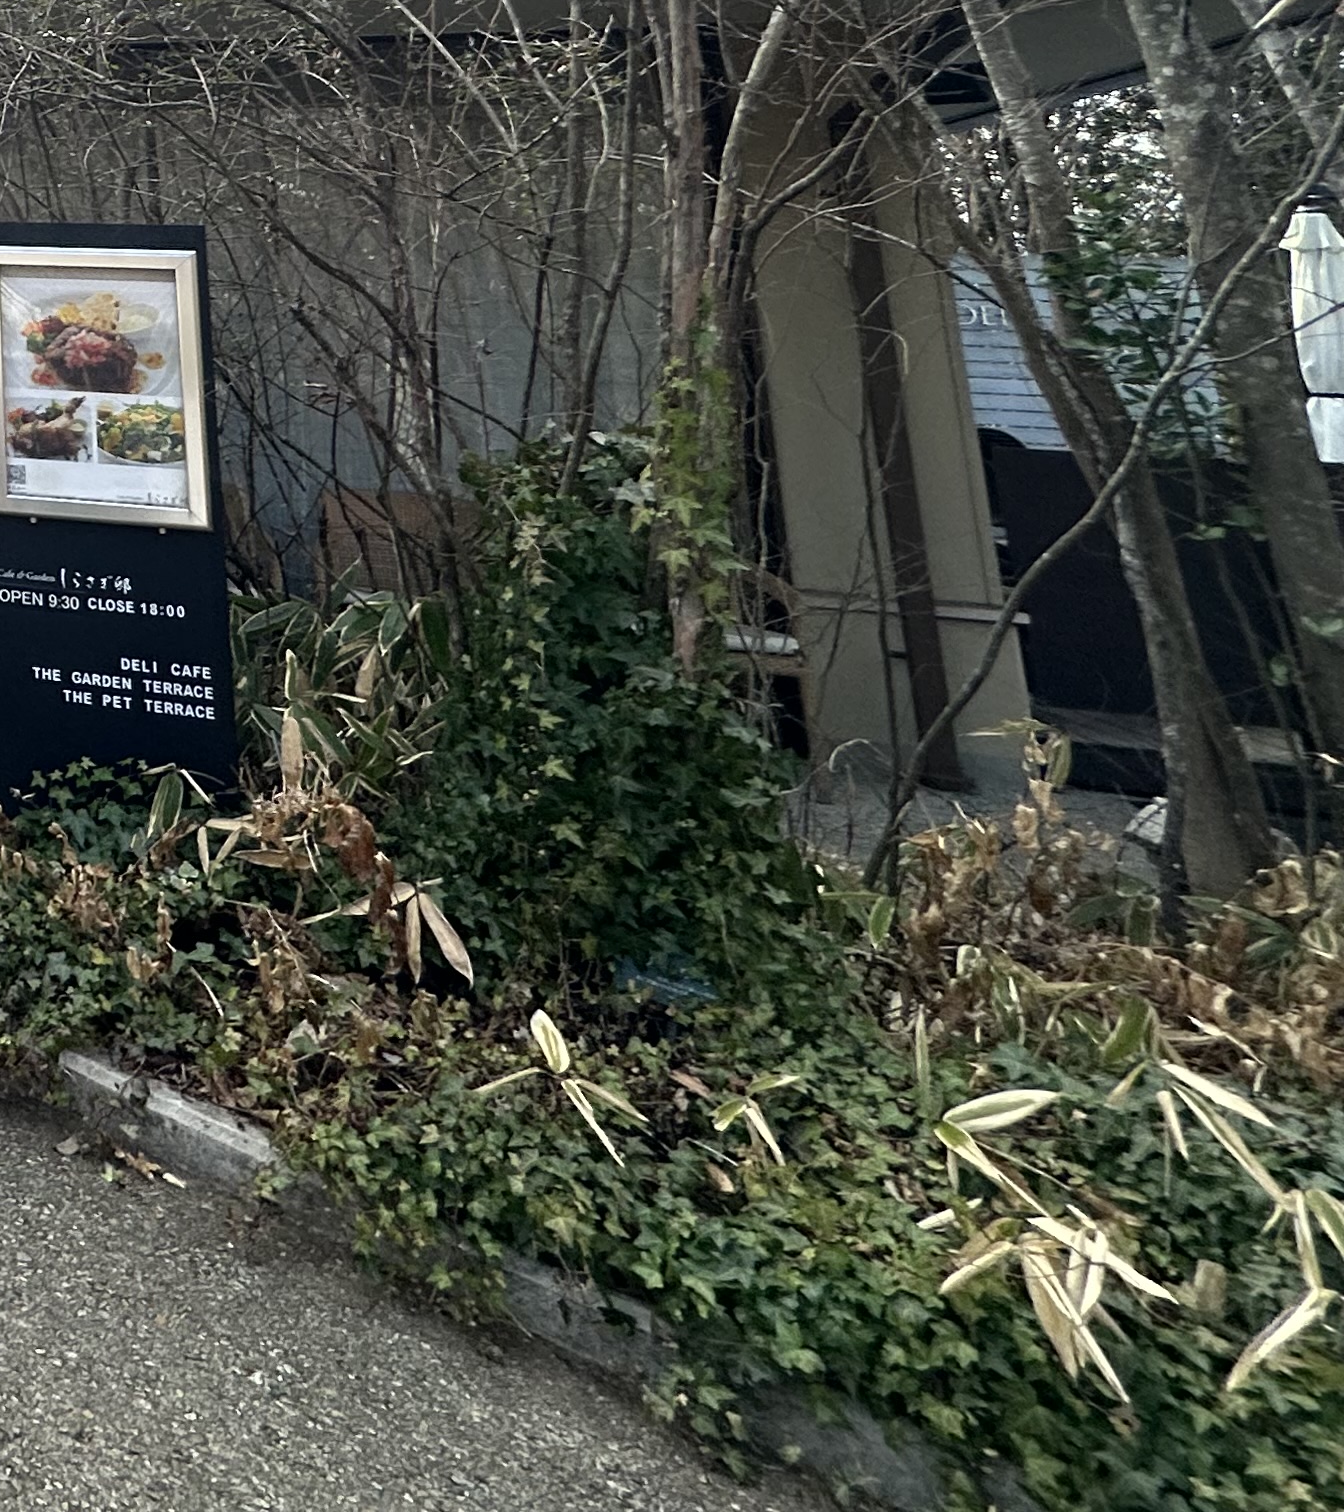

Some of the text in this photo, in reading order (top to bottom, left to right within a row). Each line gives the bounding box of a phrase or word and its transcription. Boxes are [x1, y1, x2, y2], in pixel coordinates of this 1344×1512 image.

[26, 571, 56, 583] Garden
[48, 593, 80, 610] 9:30
[87, 597, 135, 614] CLOSE
[140, 602, 186, 618] 18:00
[120, 657, 212, 680] DELI CAFE
[32, 666, 214, 700] THE GARDEN TERRACE
[62, 689, 216, 720] THE PET TERRACE
